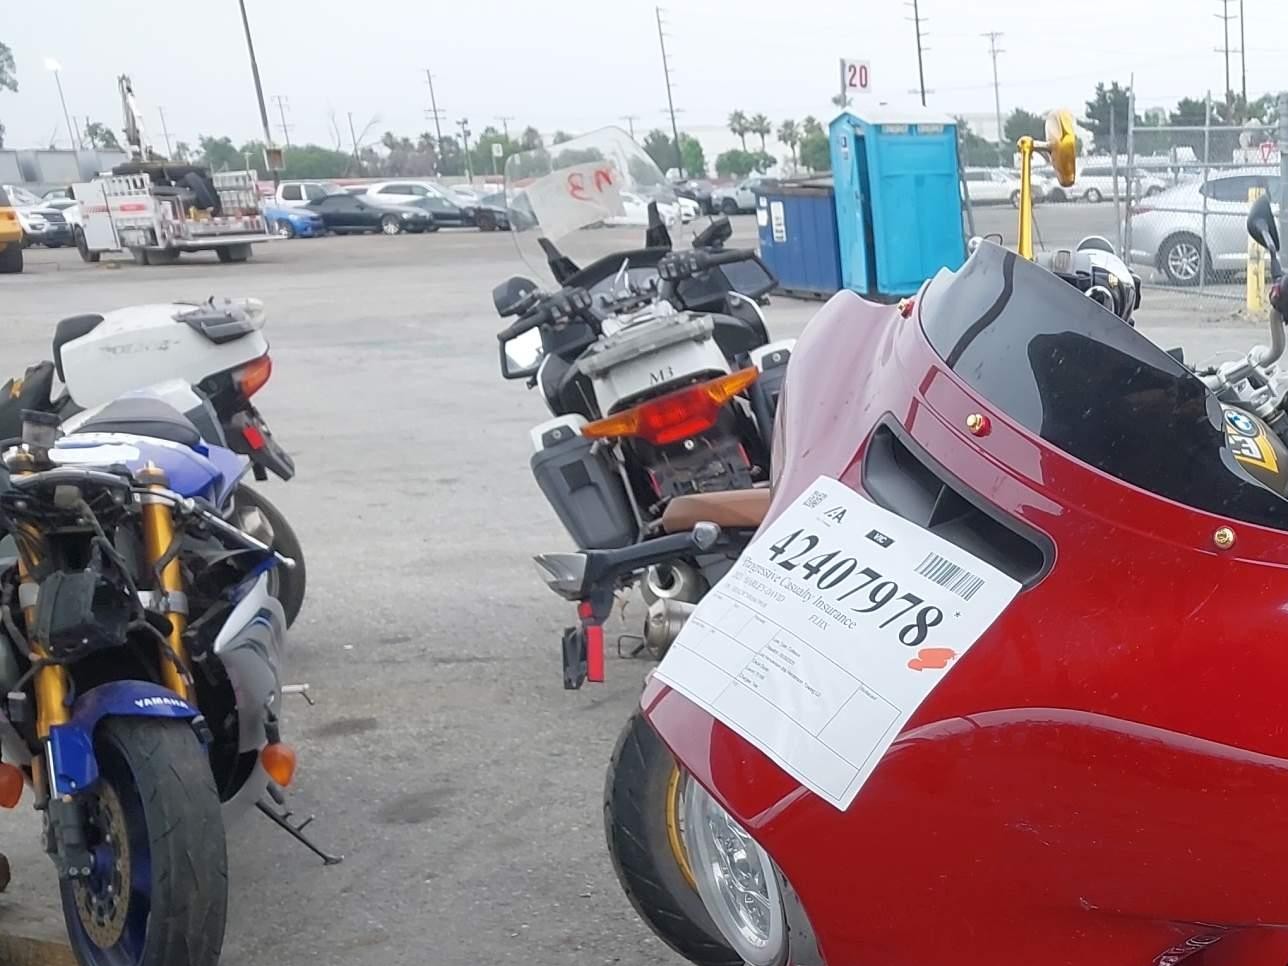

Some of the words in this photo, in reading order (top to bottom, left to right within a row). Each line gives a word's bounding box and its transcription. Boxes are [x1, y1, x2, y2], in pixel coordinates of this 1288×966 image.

[848, 64, 868, 88] 20
[769, 528, 943, 646] 42407978
[779, 577, 812, 603] Casualty
[812, 596, 857, 630] Insurance
[134, 697, 189, 709] YAMAHA
